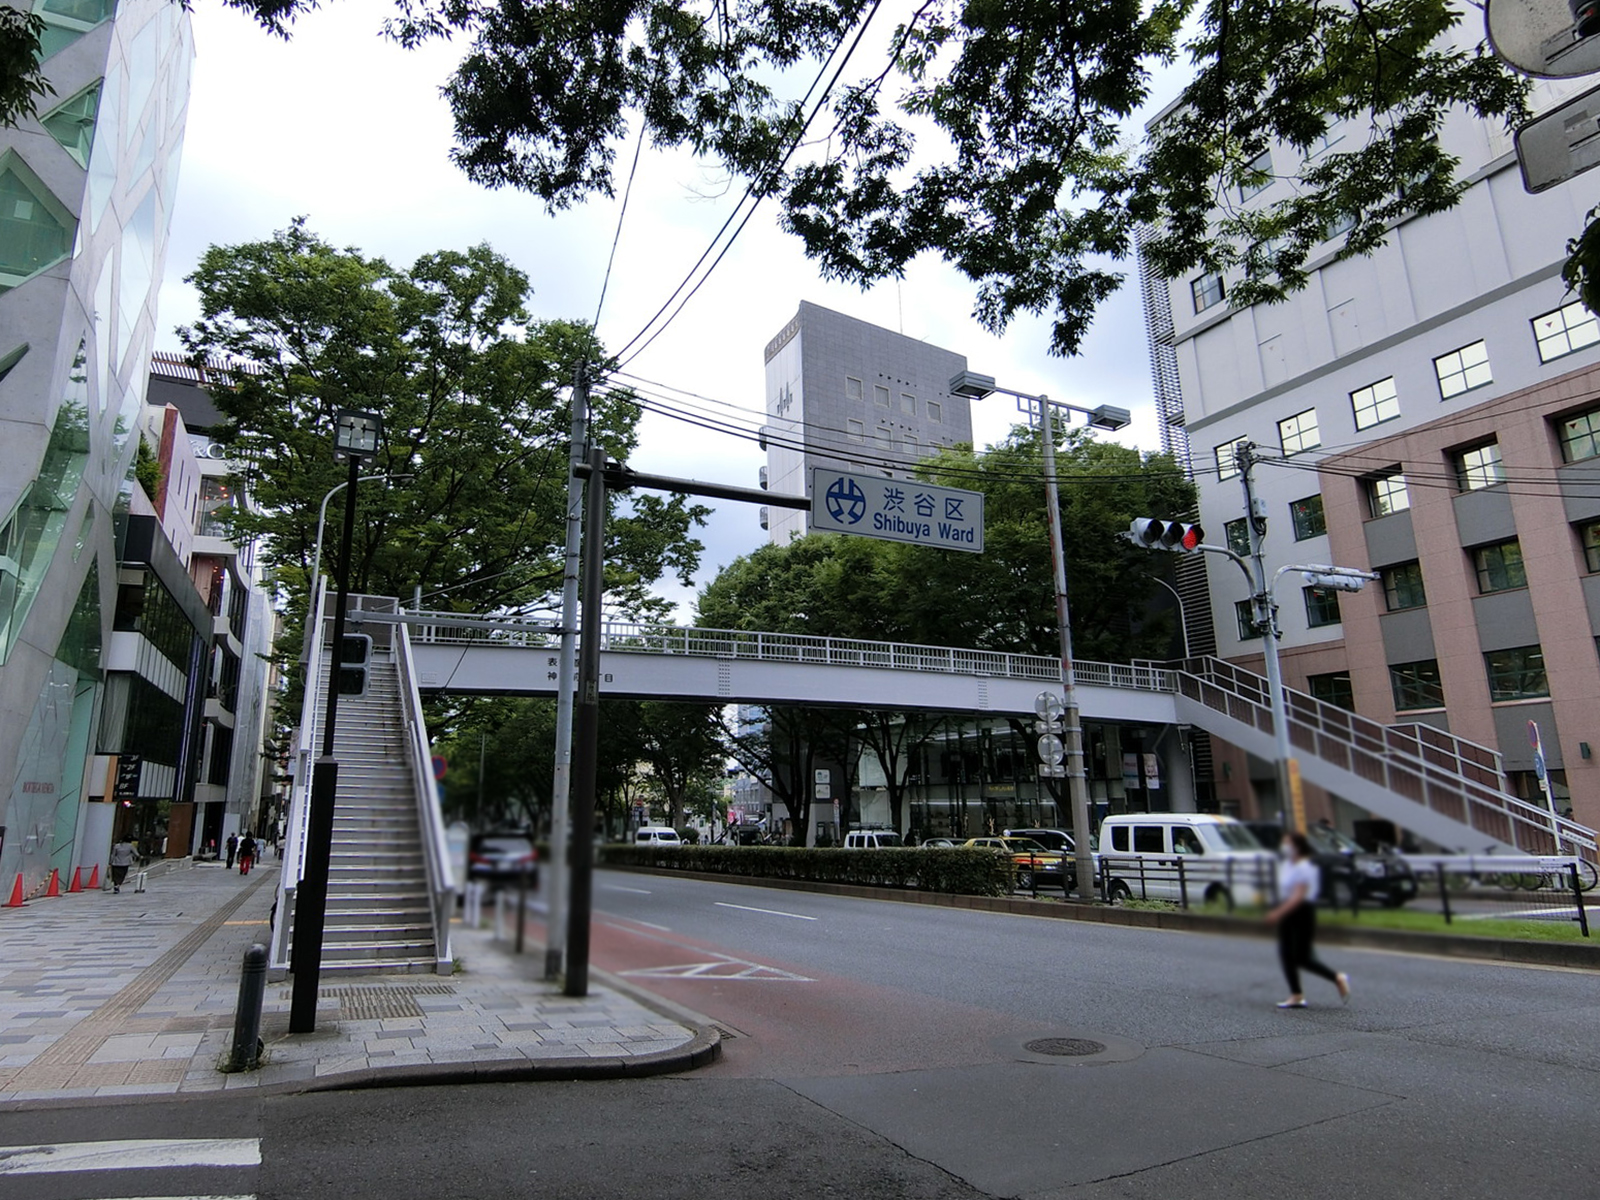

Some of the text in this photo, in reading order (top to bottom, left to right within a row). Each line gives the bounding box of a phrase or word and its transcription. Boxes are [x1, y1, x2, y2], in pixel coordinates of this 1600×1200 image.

[883, 487, 964, 522] 渋谷区
[873, 512, 974, 543] Shibuya Ward
